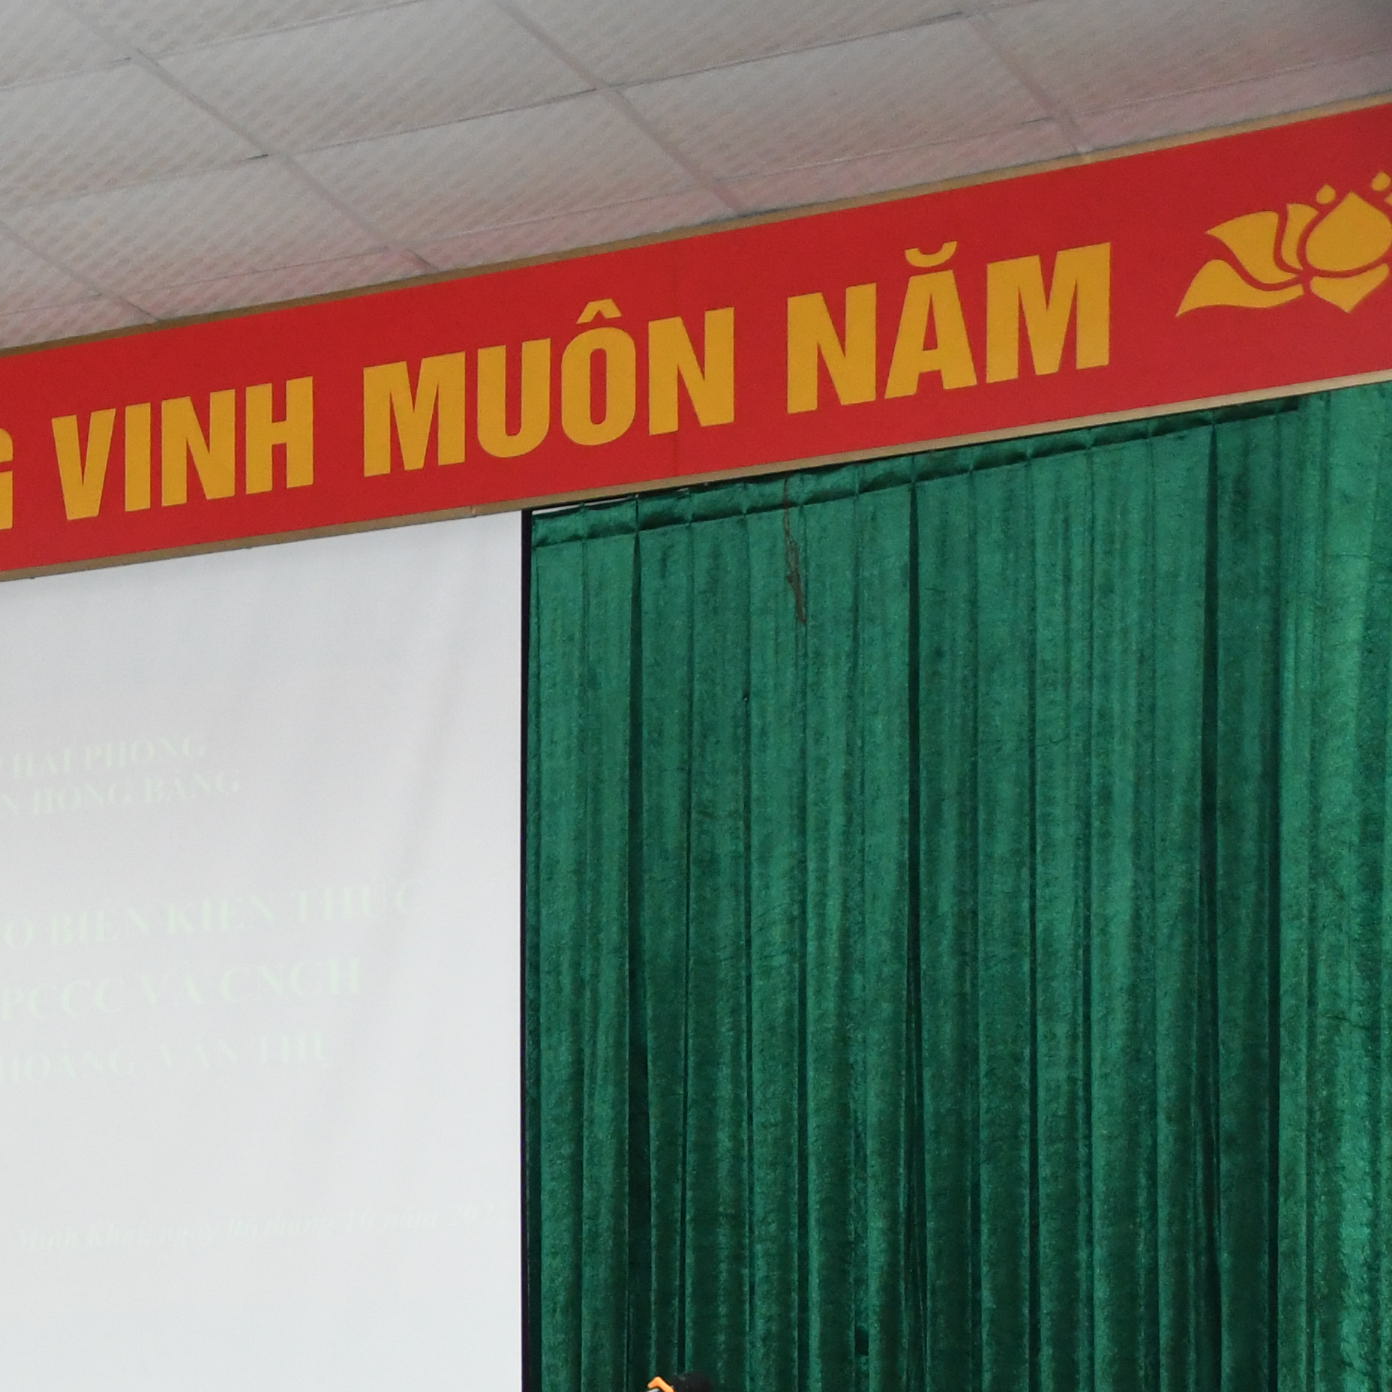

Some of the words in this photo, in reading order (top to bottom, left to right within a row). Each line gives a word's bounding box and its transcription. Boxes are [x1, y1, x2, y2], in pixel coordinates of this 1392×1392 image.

[52, 376, 314, 521] VINH
[363, 298, 735, 477] MUÔN
[787, 241, 1111, 414] NĂM
